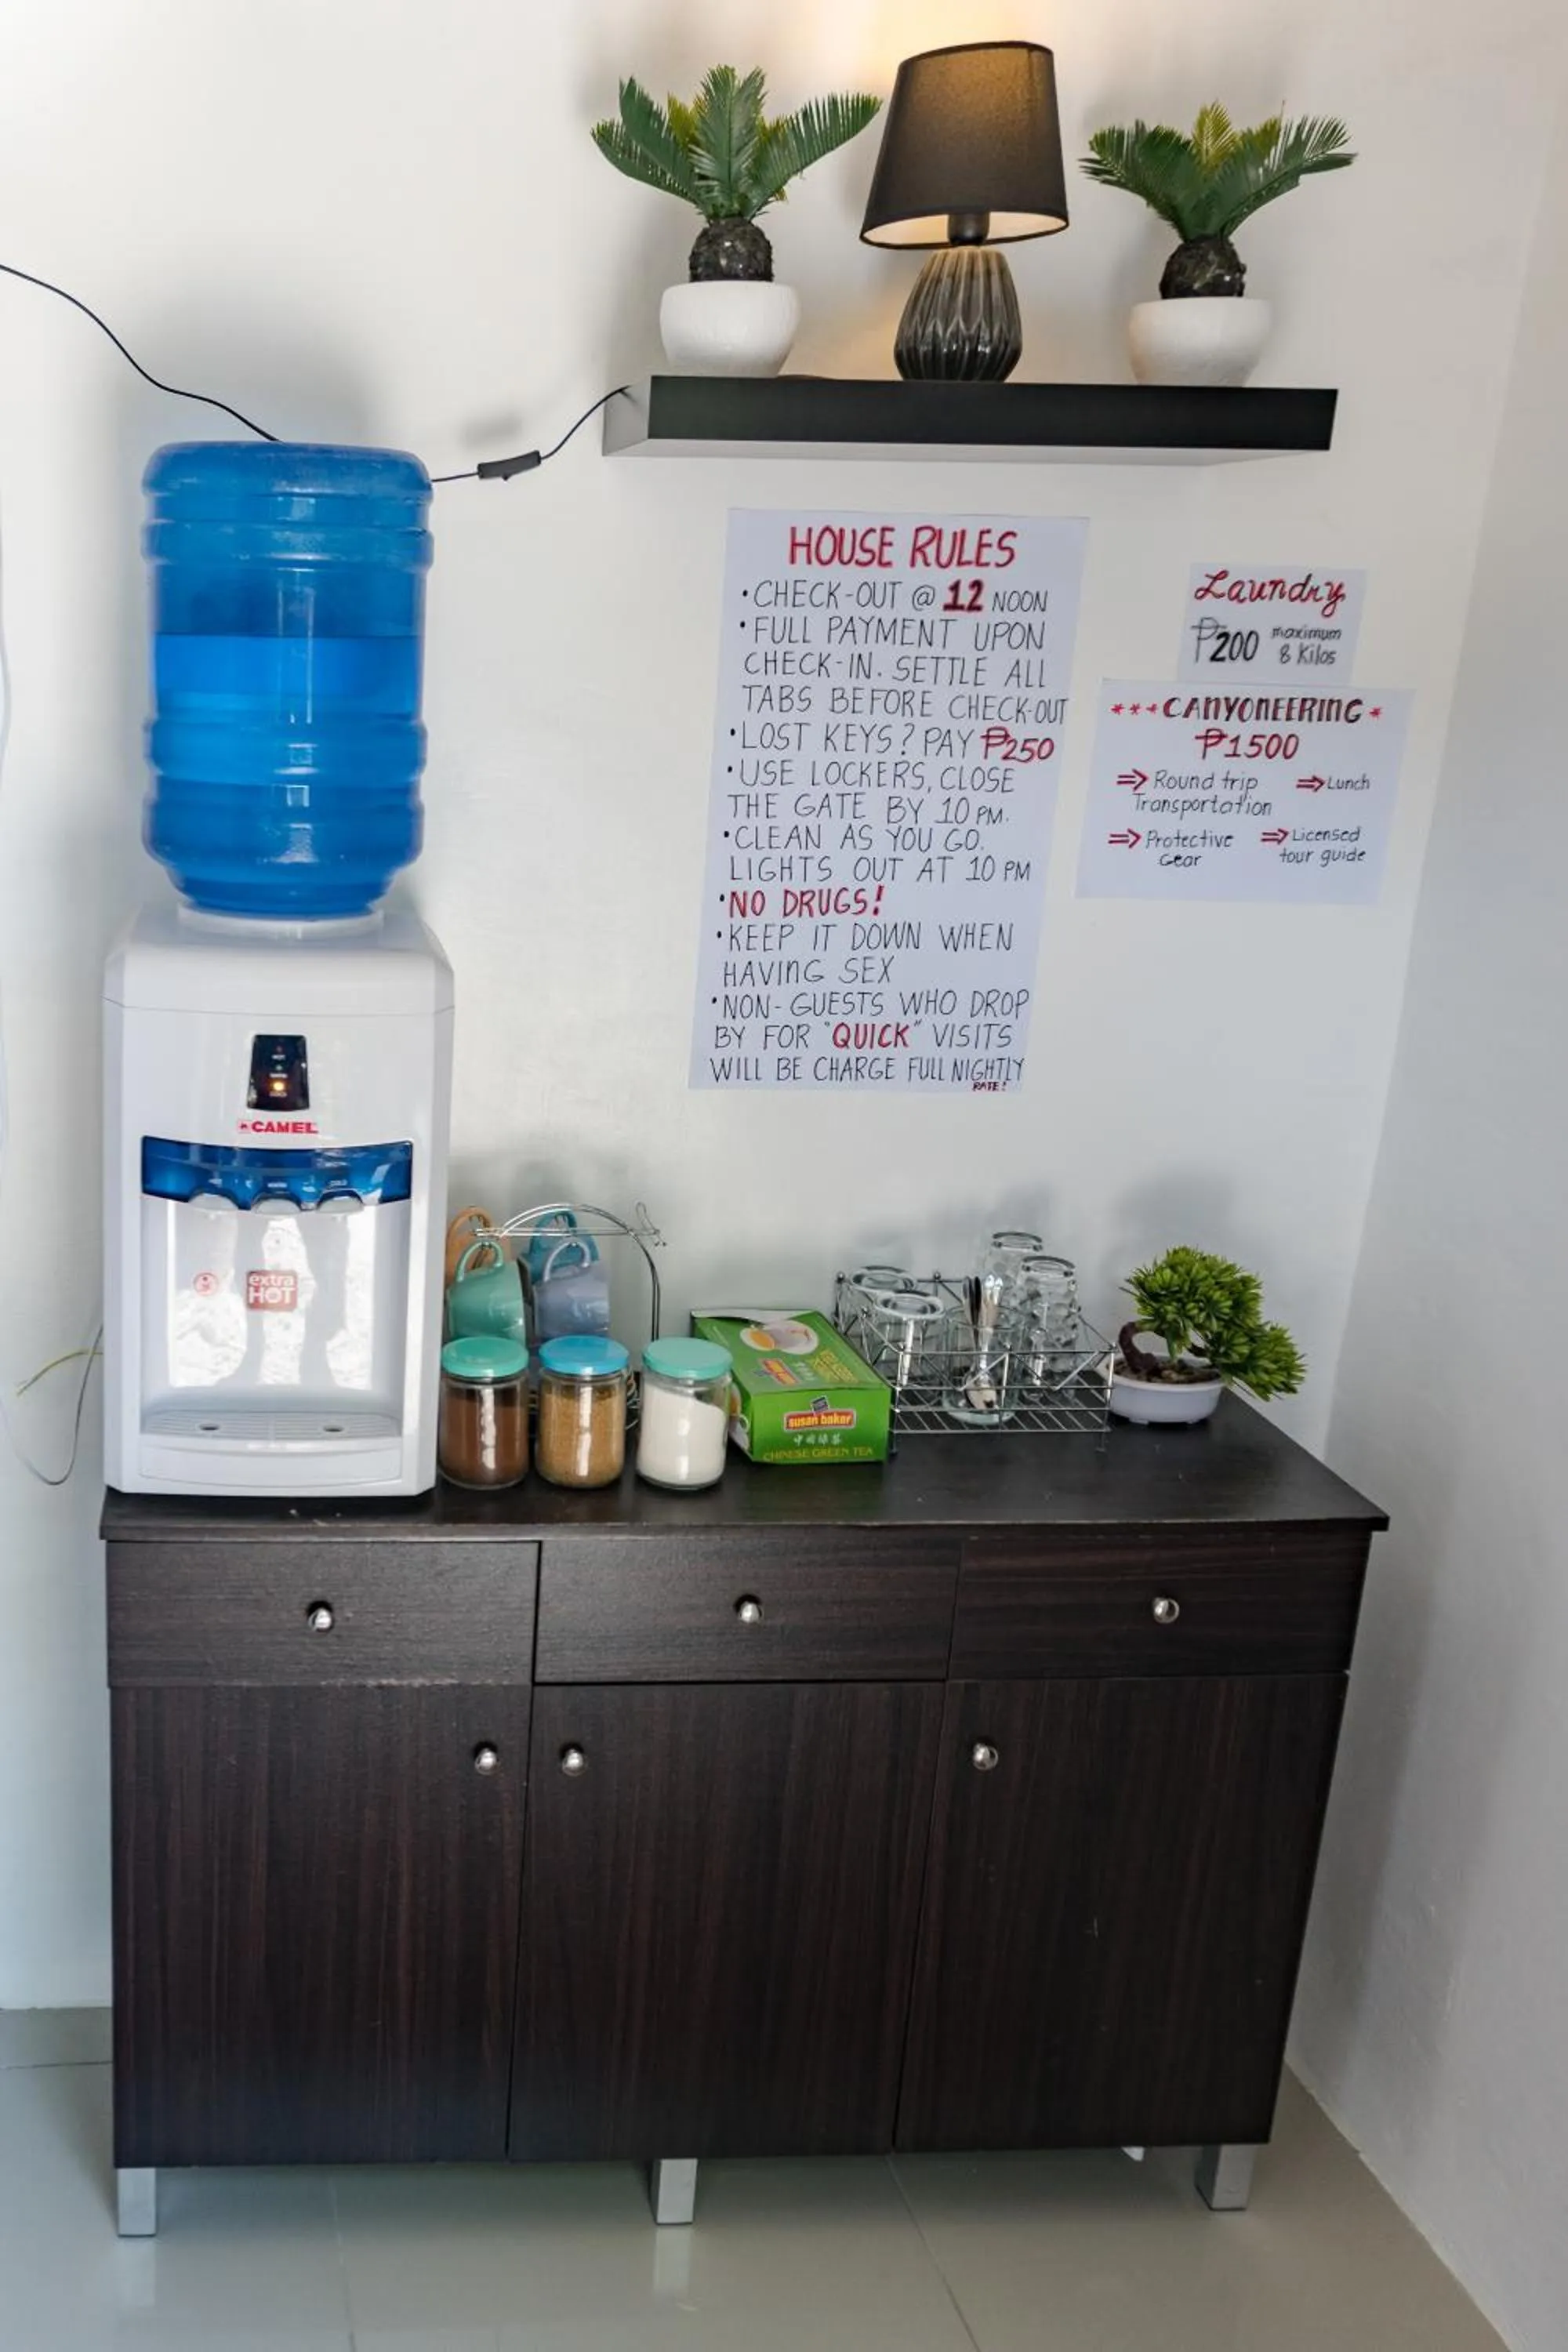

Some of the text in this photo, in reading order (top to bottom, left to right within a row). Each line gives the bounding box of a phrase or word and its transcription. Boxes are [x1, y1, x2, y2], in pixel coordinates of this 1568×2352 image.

[789, 525, 1018, 568] HOUSE RULES
[753, 579, 1048, 613] CHECK-OUT @ 12 NOON
[1194, 569, 1346, 618] Laundry
[753, 616, 1046, 652] FULL PAYMENT UPON
[1271, 624, 1341, 641] maximum
[1279, 644, 1291, 664] 8
[892, 656, 988, 686] SETTLE
[1004, 659, 1047, 688] ALL
[742, 684, 1069, 724] TABS BEFORE CHECK-OUT
[740, 722, 811, 751] LOST
[924, 727, 975, 758] PAY
[739, 760, 794, 786] USE
[941, 766, 1015, 793] CLOSE
[1154, 769, 1258, 799] Round trip
[1327, 773, 1370, 791] Lunch
[728, 793, 779, 819] THE
[794, 792, 866, 819] GATE
[887, 797, 924, 825] BY
[935, 797, 970, 824] 10
[1132, 793, 1273, 820] Transportation
[734, 825, 822, 851] CLEAN
[840, 824, 873, 851] AS
[885, 826, 932, 852] YOU
[1146, 829, 1234, 850] Protective
[1293, 826, 1361, 844] Licensed
[730, 855, 1032, 883] LIGHTS OUT AT 10 PM
[1279, 847, 1367, 868] tour guide
[729, 884, 885, 918] NO DRUGS!
[729, 921, 1014, 953] KEEP IT DOWN WHEN
[837, 955, 895, 985] SEX
[899, 989, 957, 1017] WHO
[969, 988, 1030, 1019] DROP
[714, 1025, 746, 1049] BY
[763, 1025, 811, 1050] FOR
[932, 1022, 1013, 1049] VISITS
[710, 1055, 1025, 1083] WILL BE CHARGE FULL NIGHTLY
[251, 1120, 319, 1134] CAMEL
[248, 1274, 295, 1287] extra
[248, 1287, 296, 1305] HOT
[788, 1412, 852, 1428] susan baker
[854, 1446, 873, 1457] TEA
